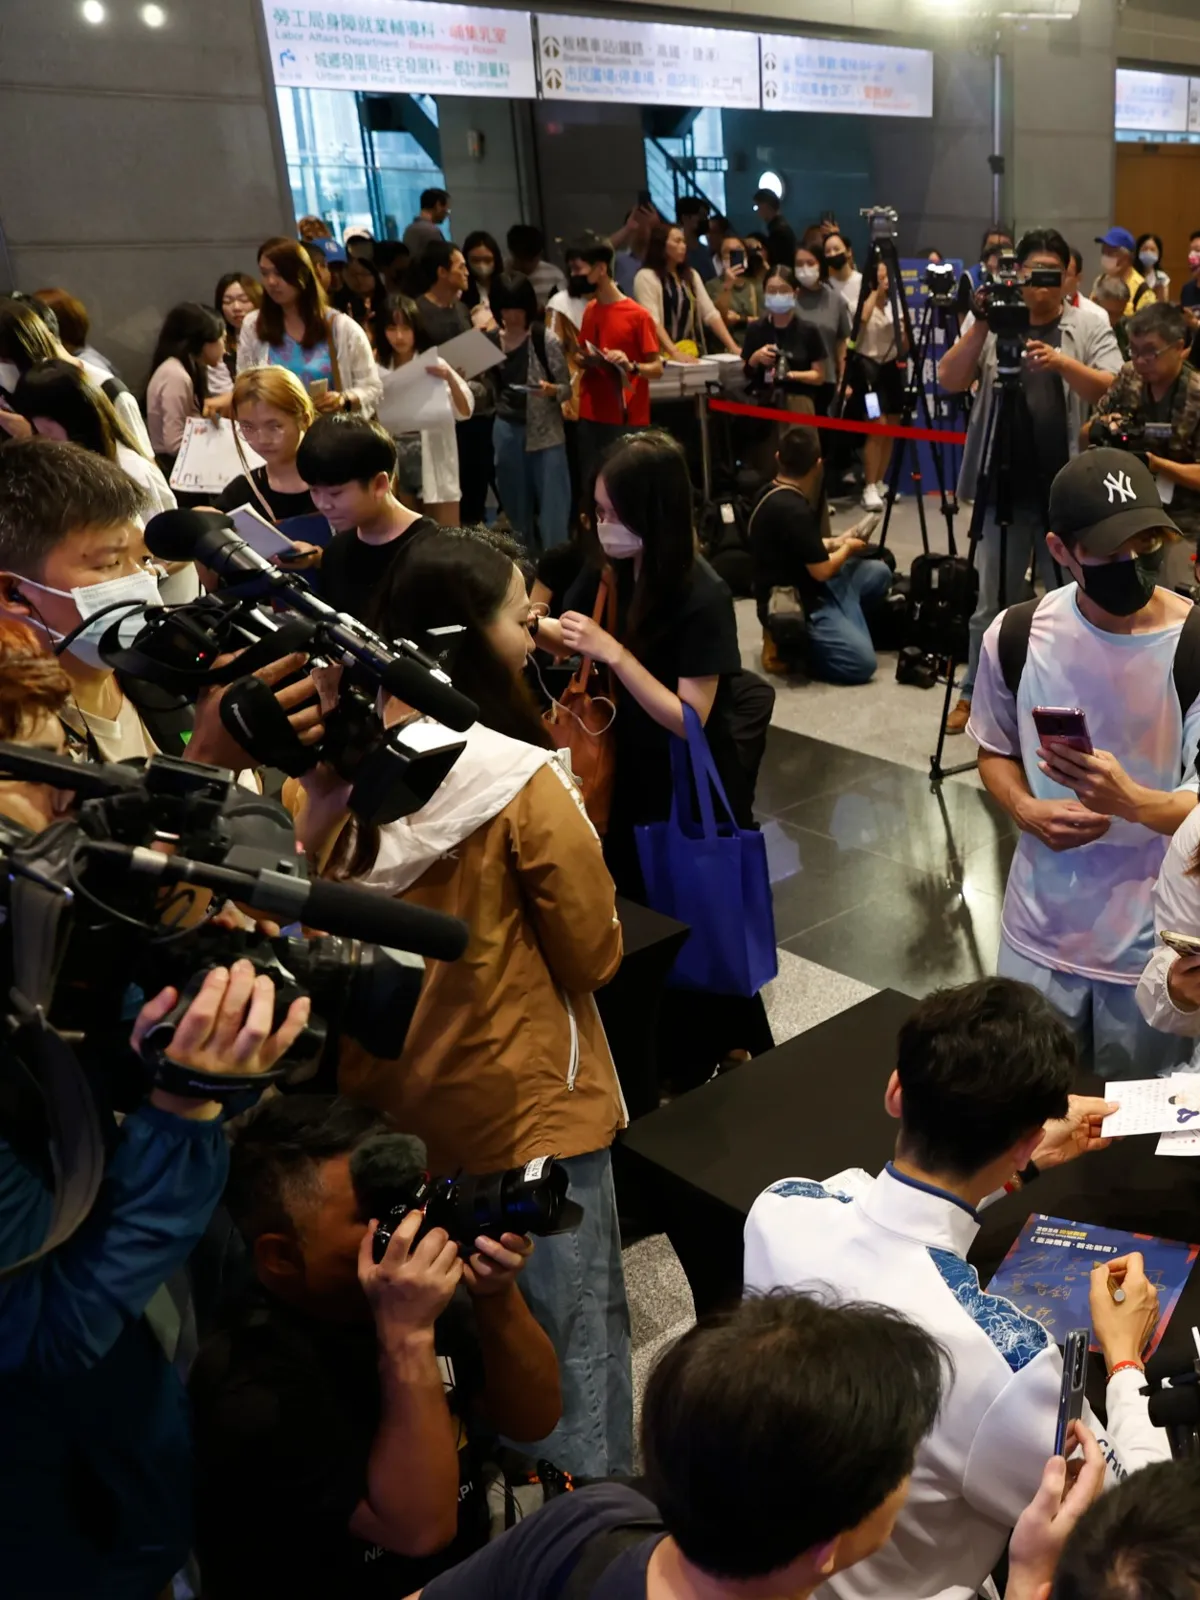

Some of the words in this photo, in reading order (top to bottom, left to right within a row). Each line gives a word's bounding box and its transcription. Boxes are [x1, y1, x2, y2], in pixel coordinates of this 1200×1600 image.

[275, 28, 304, 41] Labor
[309, 32, 340, 44] Affairs
[344, 35, 399, 48] Department
[349, 73, 367, 83] and
[1103, 470, 1137, 504] NY
